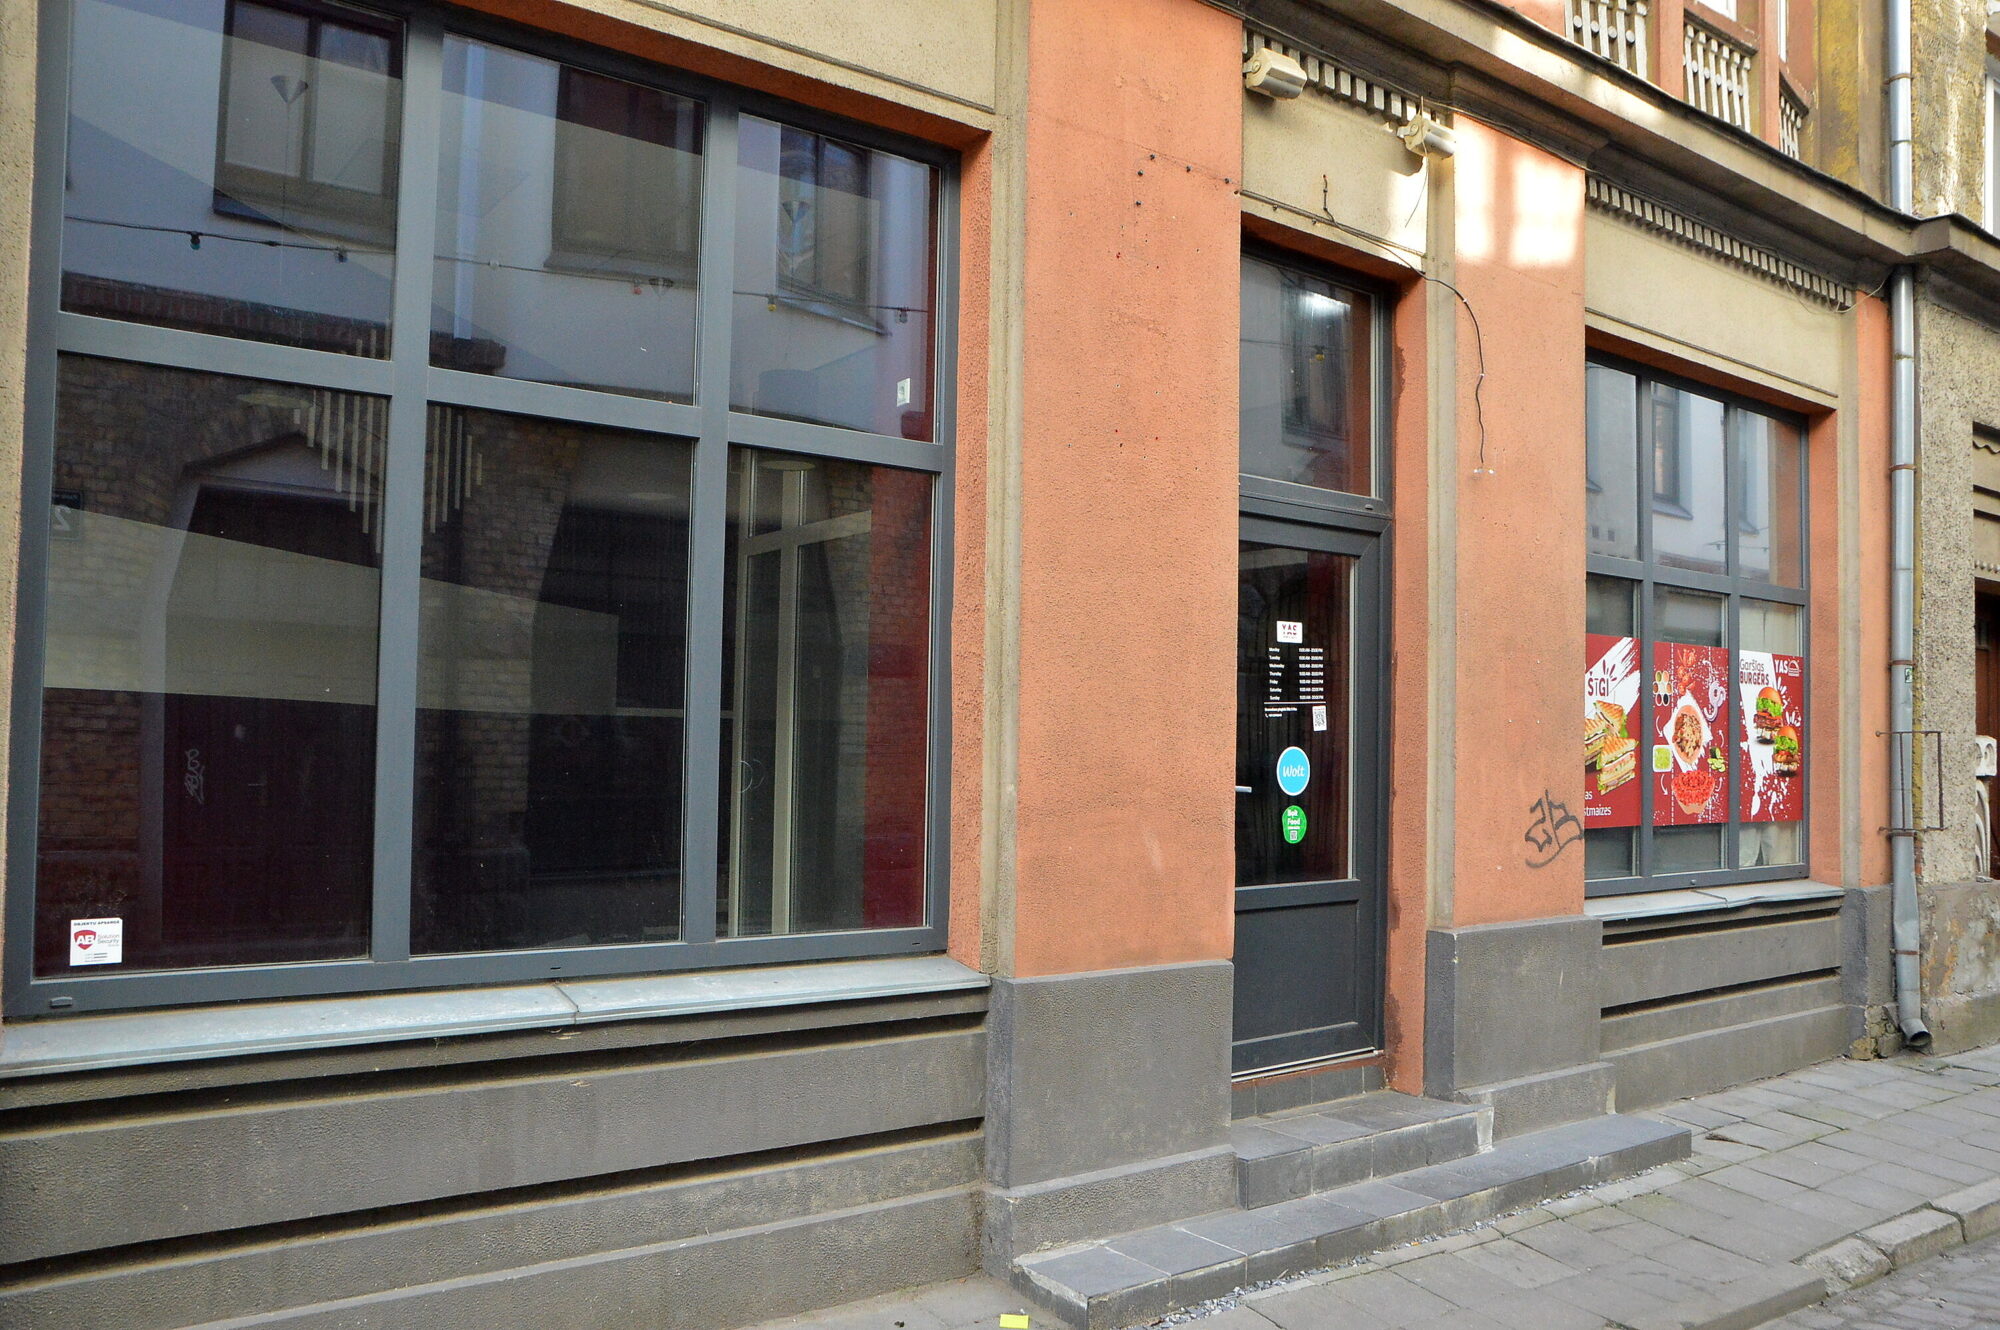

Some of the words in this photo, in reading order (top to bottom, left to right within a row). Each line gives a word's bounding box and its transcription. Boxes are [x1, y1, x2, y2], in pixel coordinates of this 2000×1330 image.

[1774, 659, 1788, 674] YAS
[1740, 671, 1769, 685] BURGERS
[1282, 765, 1305, 777] Wolt
[77, 935, 95, 945] AB
